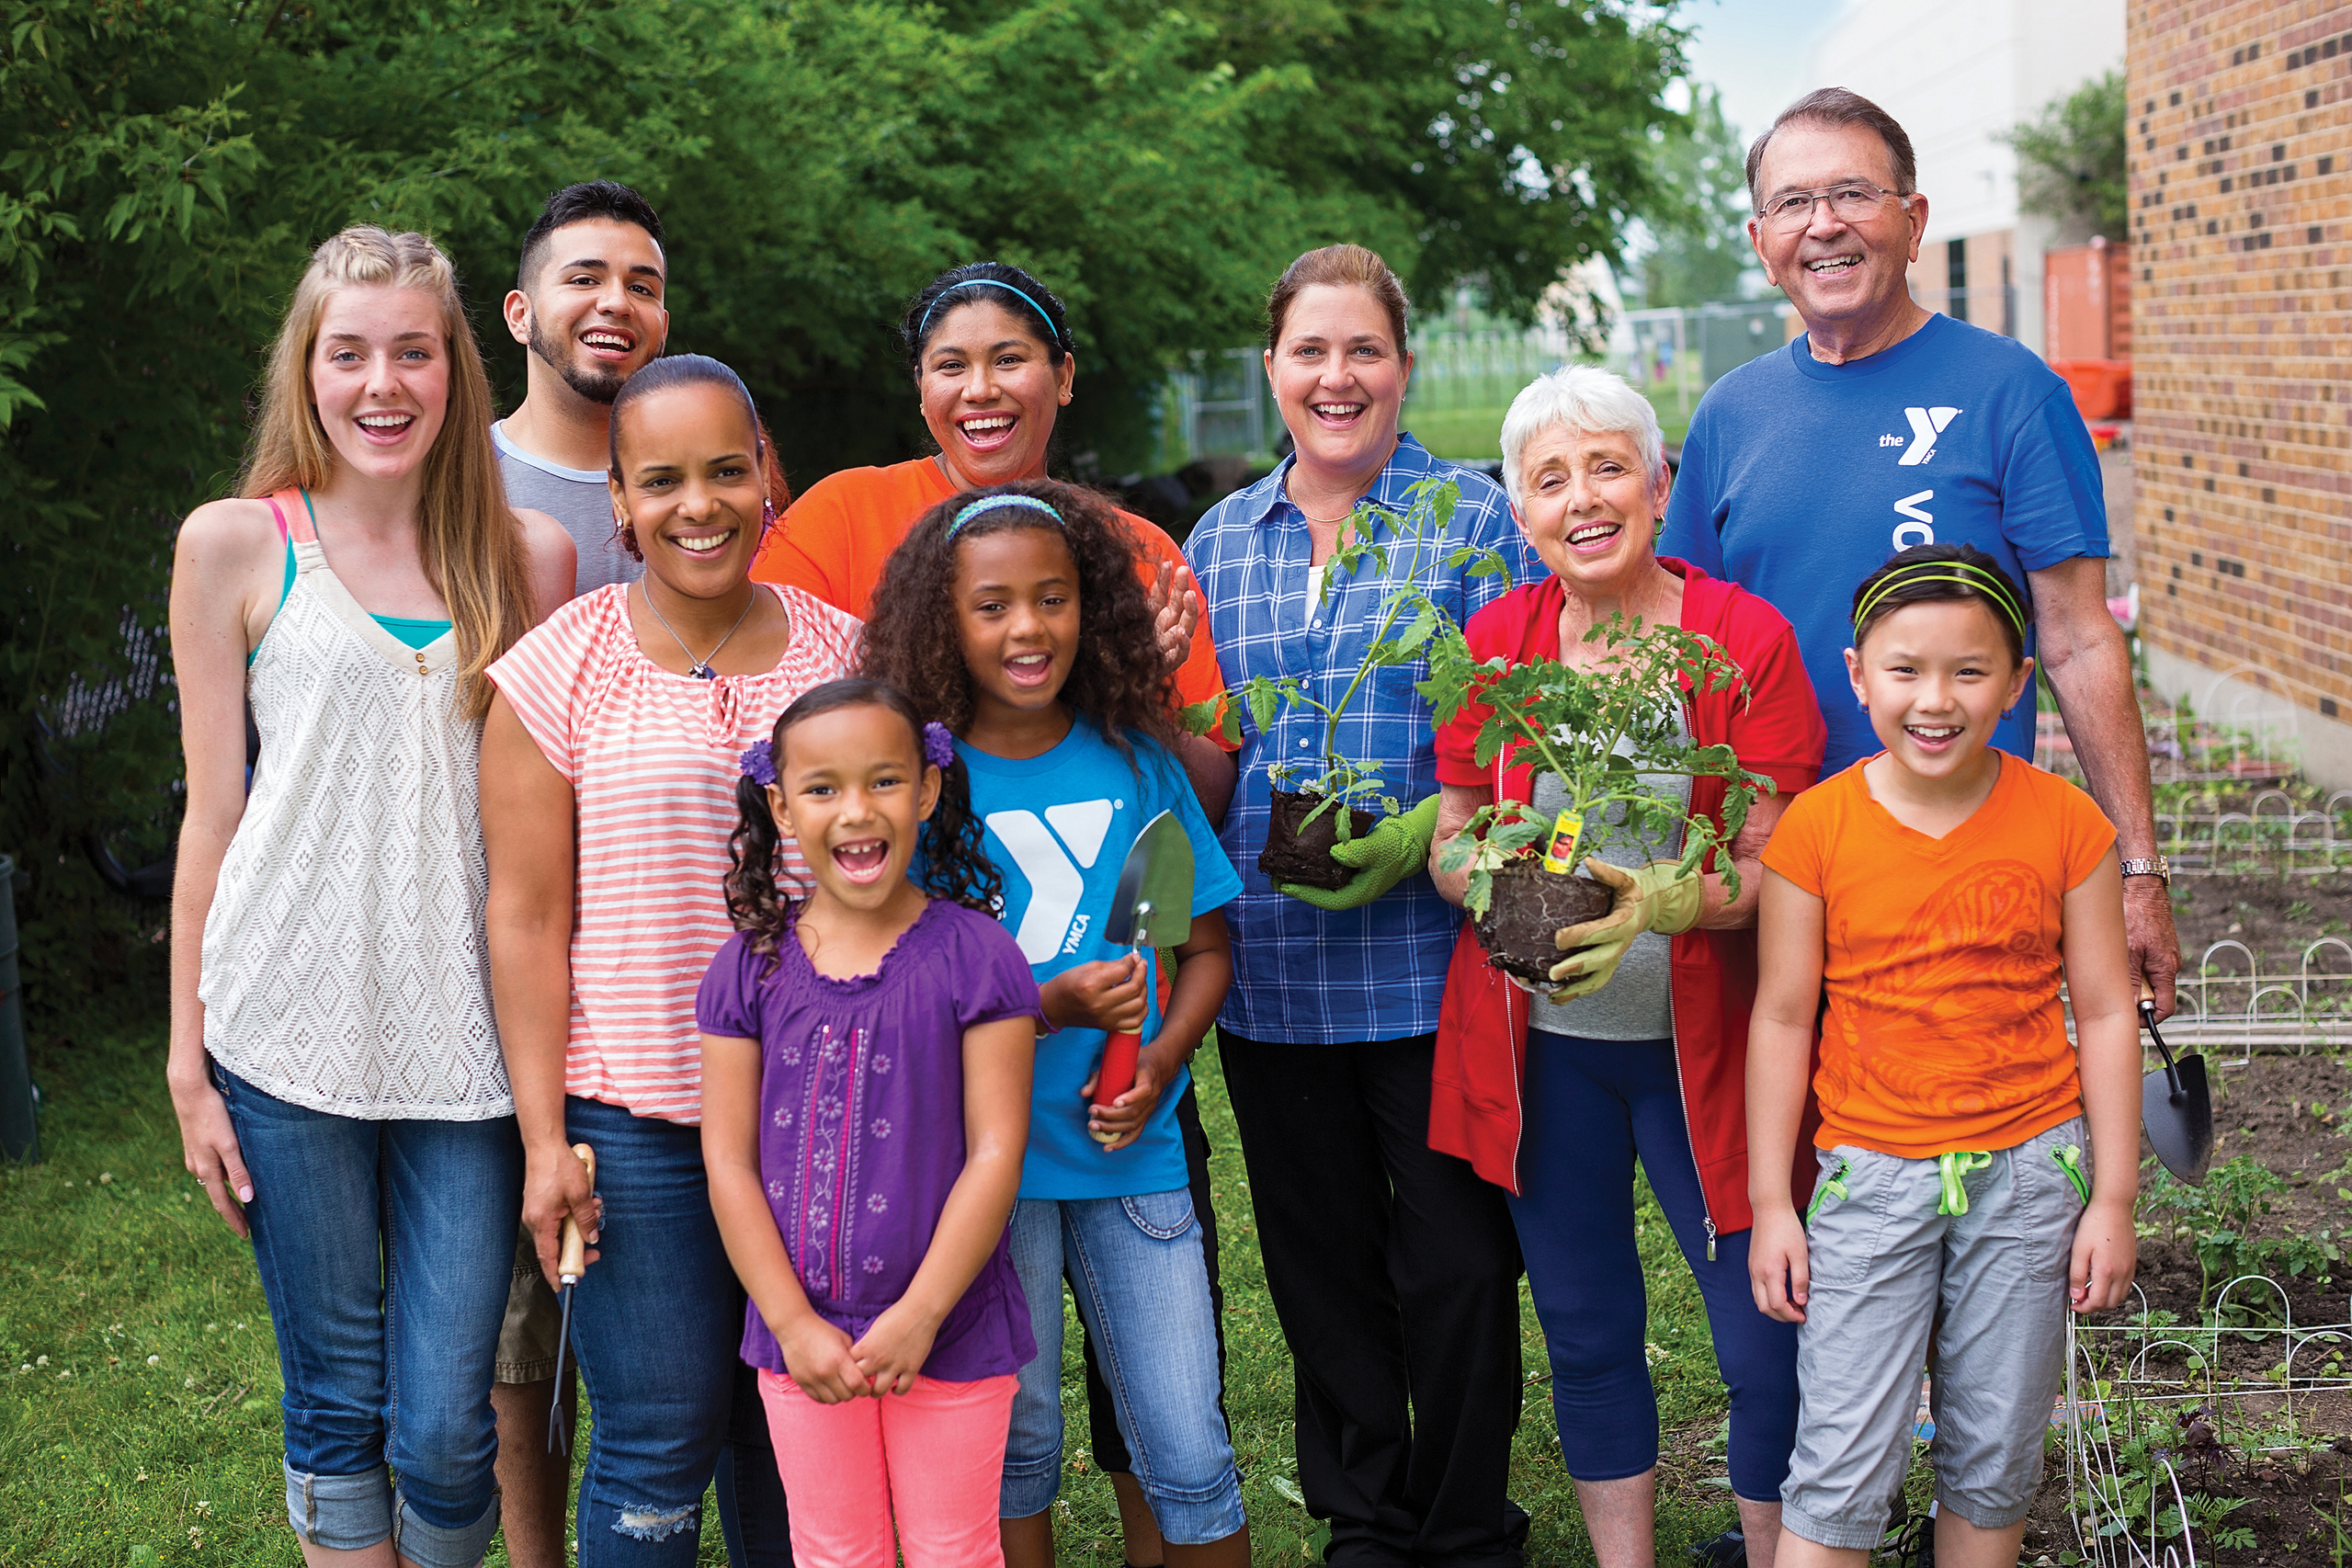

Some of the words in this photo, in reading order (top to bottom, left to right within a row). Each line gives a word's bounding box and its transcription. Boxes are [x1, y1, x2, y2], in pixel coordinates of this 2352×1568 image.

[1879, 433, 1904, 448] the
[1920, 449, 1937, 465] YMCA
[1062, 914, 1091, 955] YMCA
